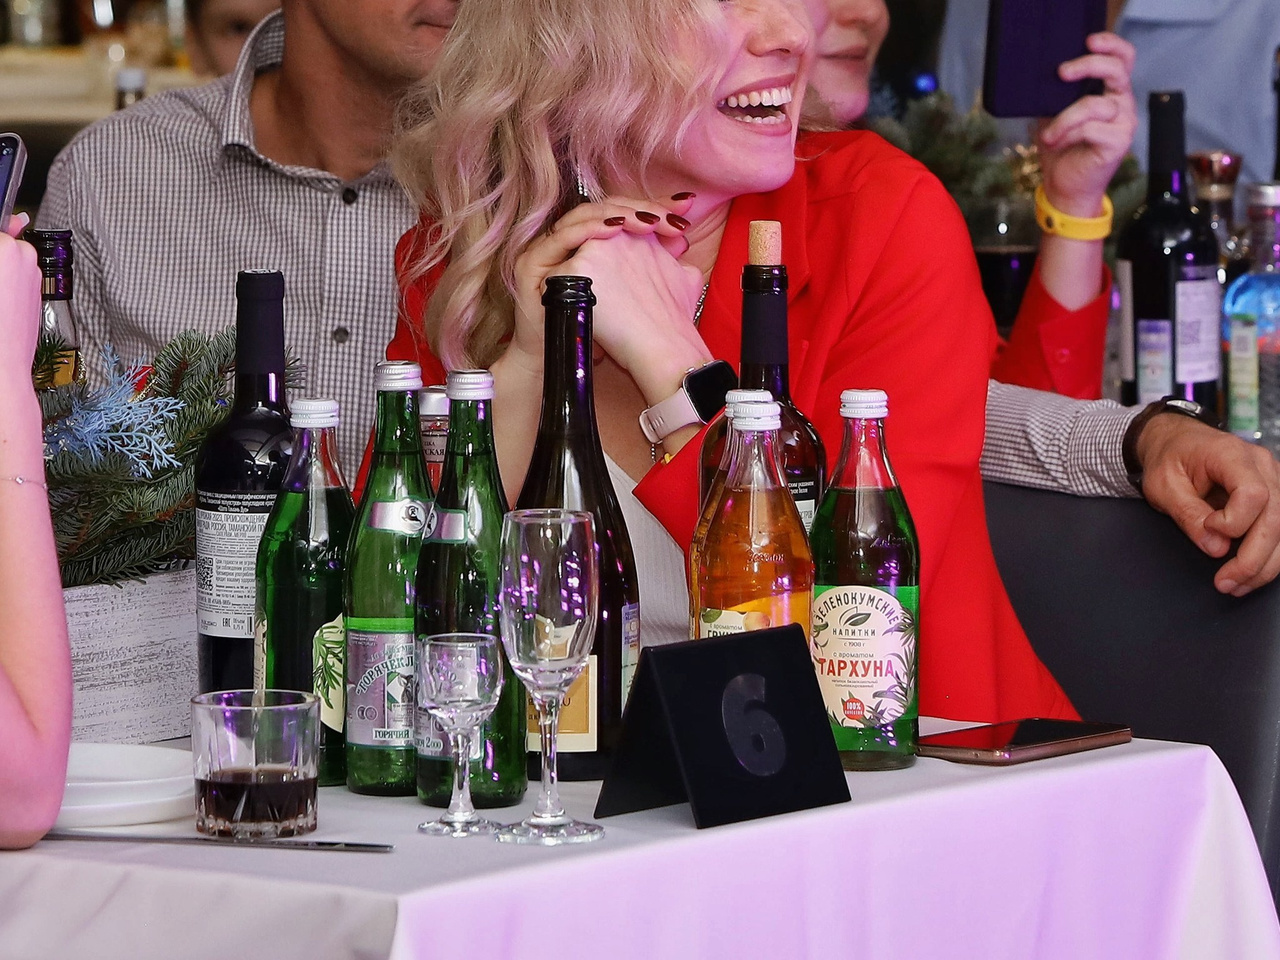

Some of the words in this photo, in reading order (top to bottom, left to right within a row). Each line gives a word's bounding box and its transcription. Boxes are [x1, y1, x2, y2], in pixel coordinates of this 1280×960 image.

[815, 592, 900, 625] ЗЕЛЕНОКУМСКИЕ
[714, 624, 743, 632] ароматом
[832, 628, 876, 636] НАПИТКИ
[838, 651, 874, 659] ароматом
[819, 658, 895, 678] ТАРХУНА
[846, 701, 861, 710] 100%
[722, 673, 787, 777] 6
[374, 729, 410, 739] ГОРЯЧИЙ
